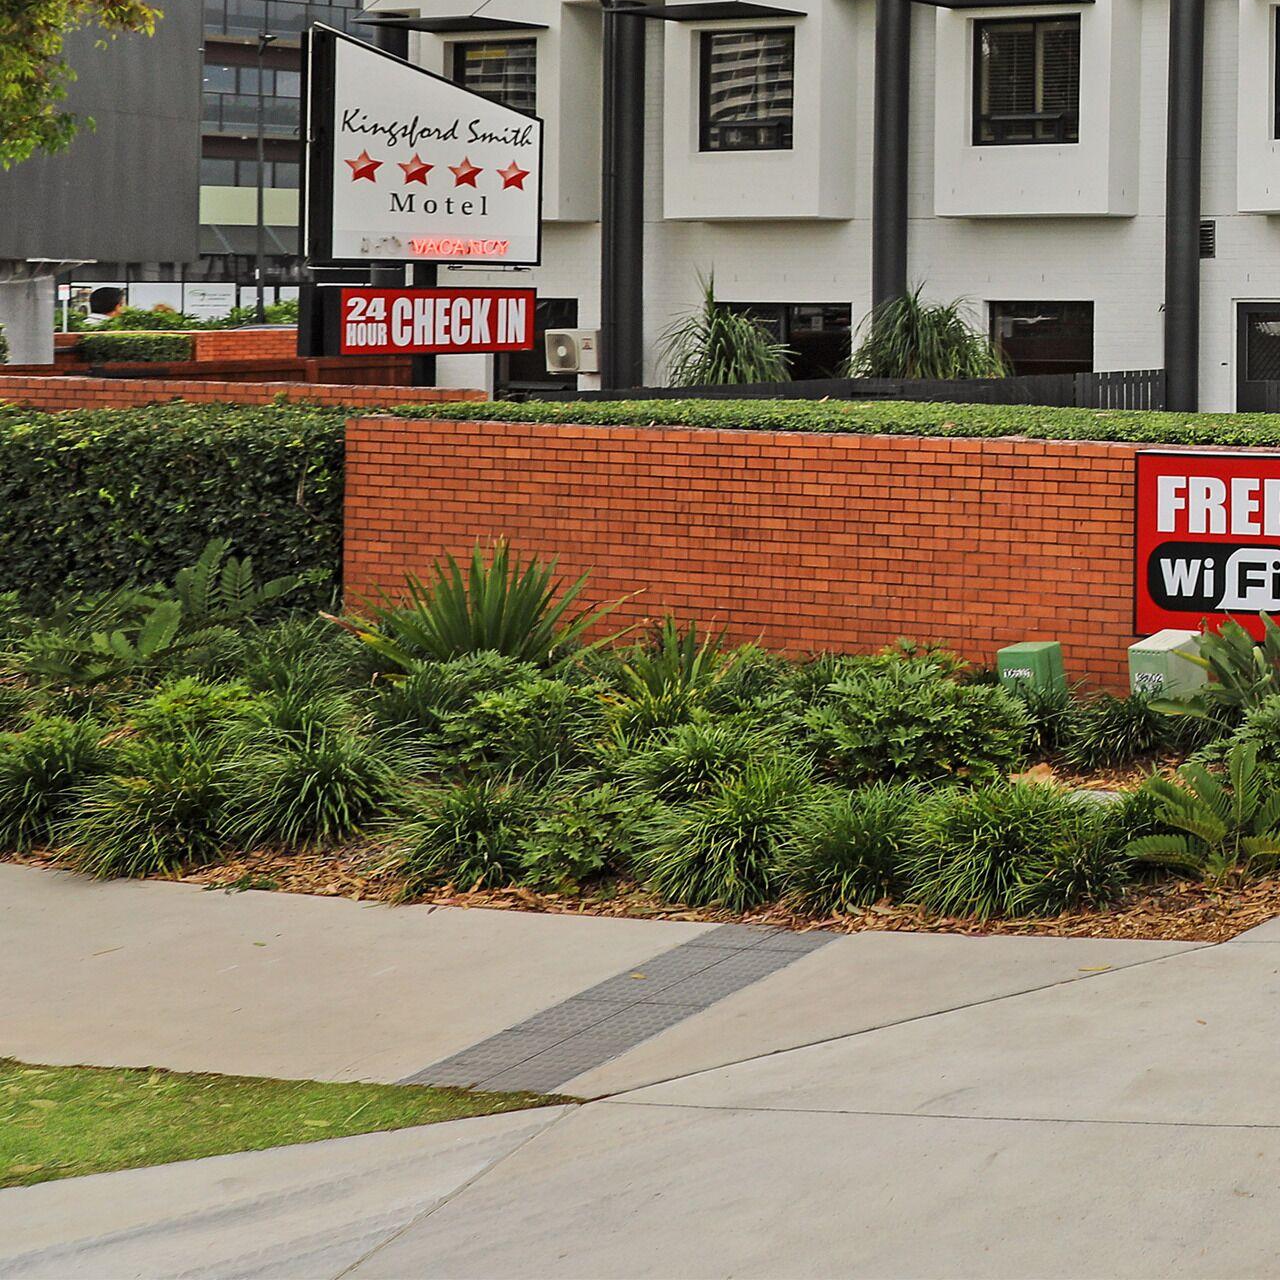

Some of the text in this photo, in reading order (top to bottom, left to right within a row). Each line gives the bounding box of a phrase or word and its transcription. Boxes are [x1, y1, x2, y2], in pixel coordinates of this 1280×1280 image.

[341, 108, 533, 148] Kingsford Smith
[389, 192, 489, 216] Motel
[410, 238, 511, 256] VACANCY
[346, 297, 387, 321] 24
[391, 297, 527, 347] CHECK IN
[346, 323, 388, 347] HOUR
